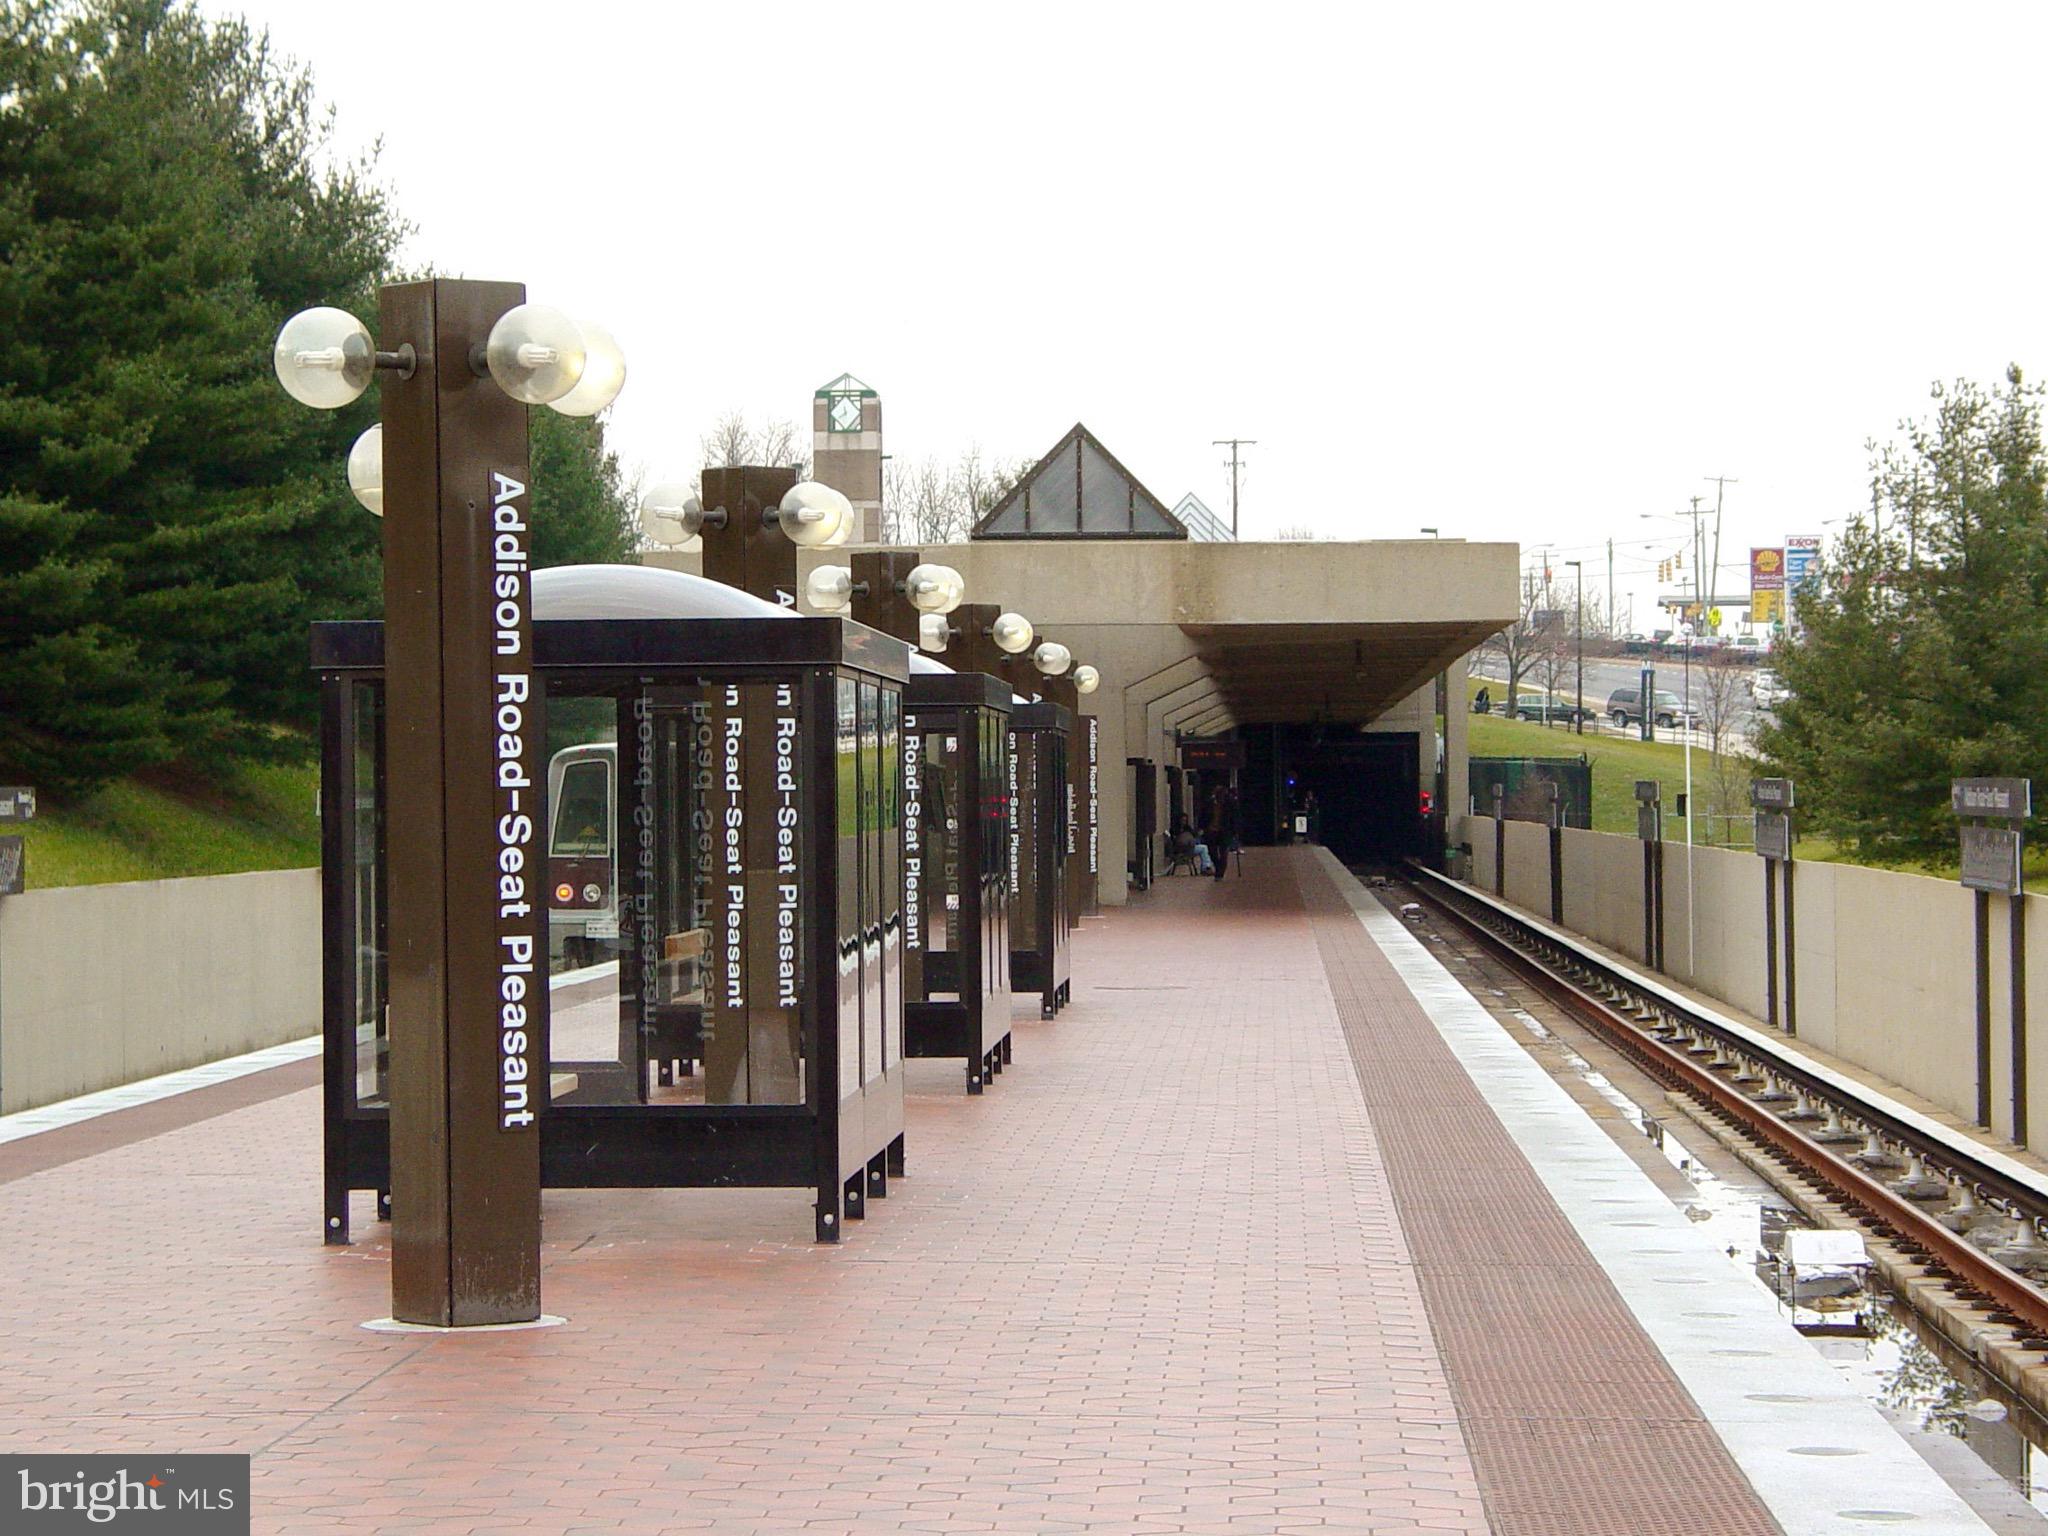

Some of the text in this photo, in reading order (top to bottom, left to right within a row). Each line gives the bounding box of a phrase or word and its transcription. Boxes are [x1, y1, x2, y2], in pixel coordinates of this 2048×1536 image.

[493, 471, 534, 1128] Addison Road-Seat Pleasant
[725, 717, 743, 874] Road-Seat
[776, 717, 798, 874] Road-Seat
[904, 735, 921, 851] Road-Seat
[1008, 754, 1019, 830] Road-Seat
[905, 858, 921, 949] Pleasant
[1009, 833, 1020, 894] Pleasant
[727, 884, 744, 1008] Pleasant
[778, 884, 798, 1008] Pleasant
